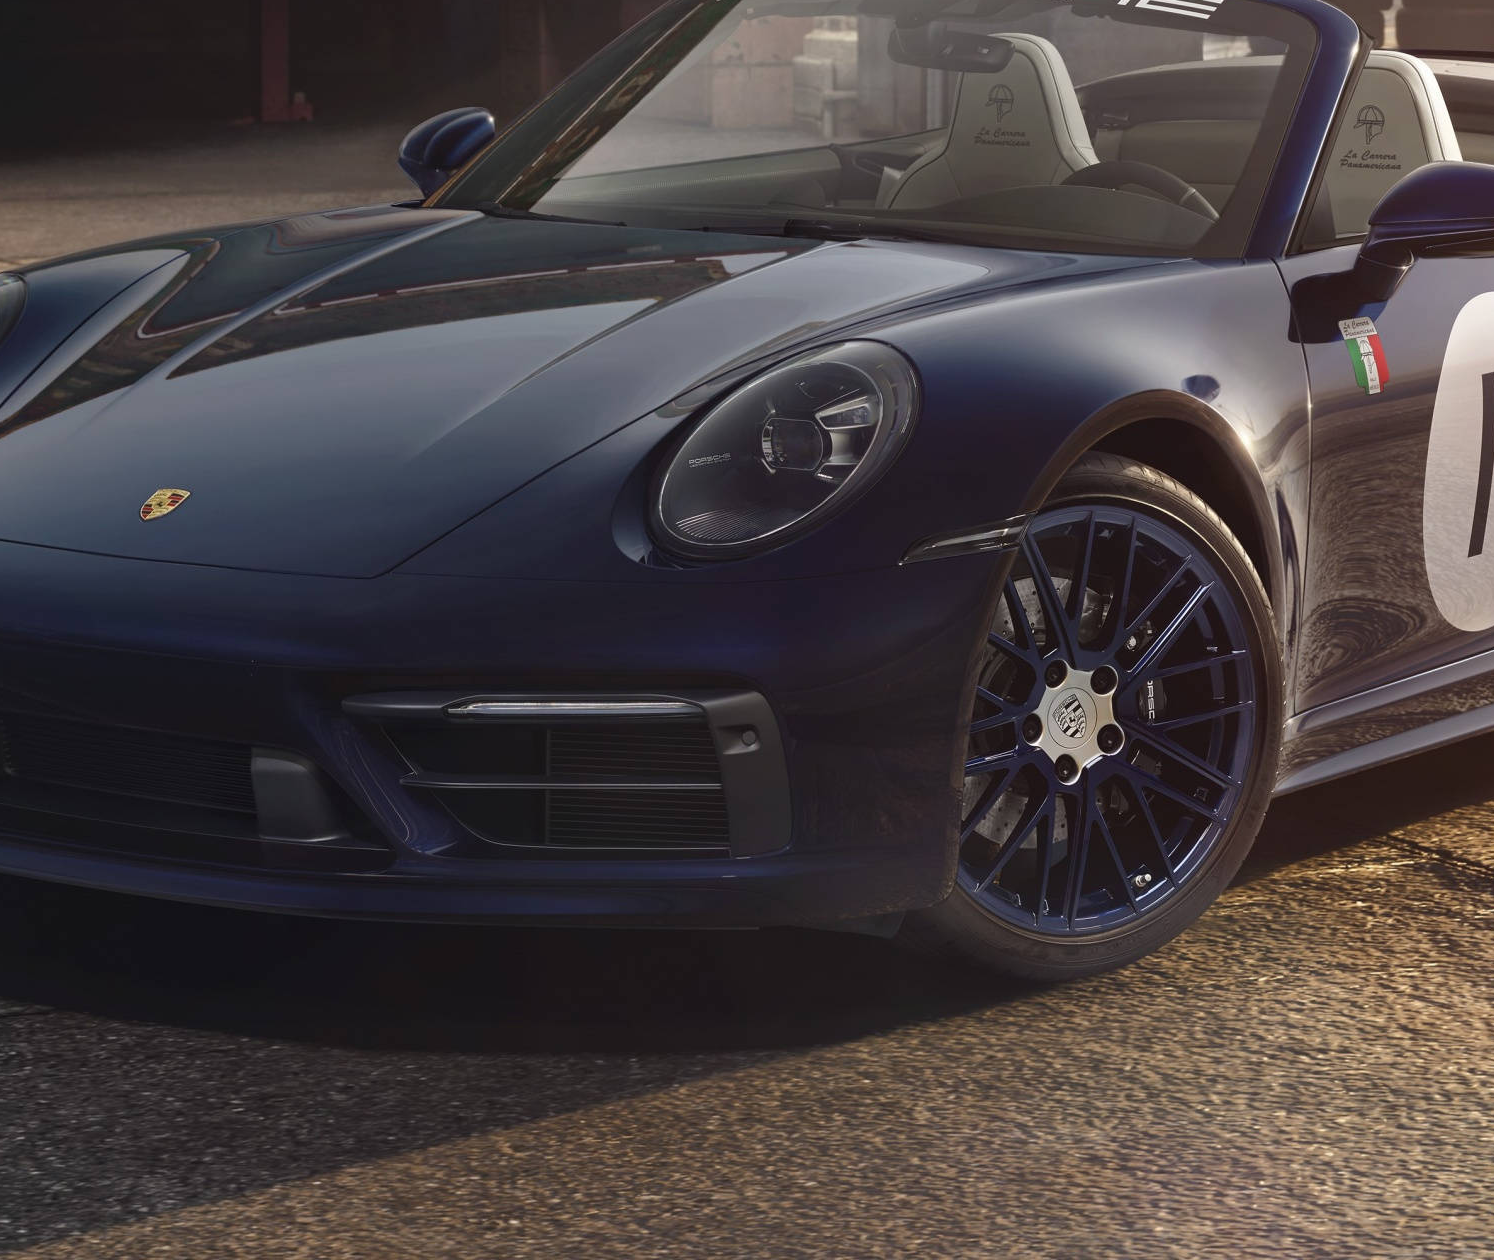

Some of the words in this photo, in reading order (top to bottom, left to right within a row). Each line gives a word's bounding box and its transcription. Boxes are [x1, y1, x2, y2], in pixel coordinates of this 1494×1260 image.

[1343, 149, 1358, 159] La
[1361, 149, 1397, 161] Carrera
[1339, 158, 1402, 170] Panamericana
